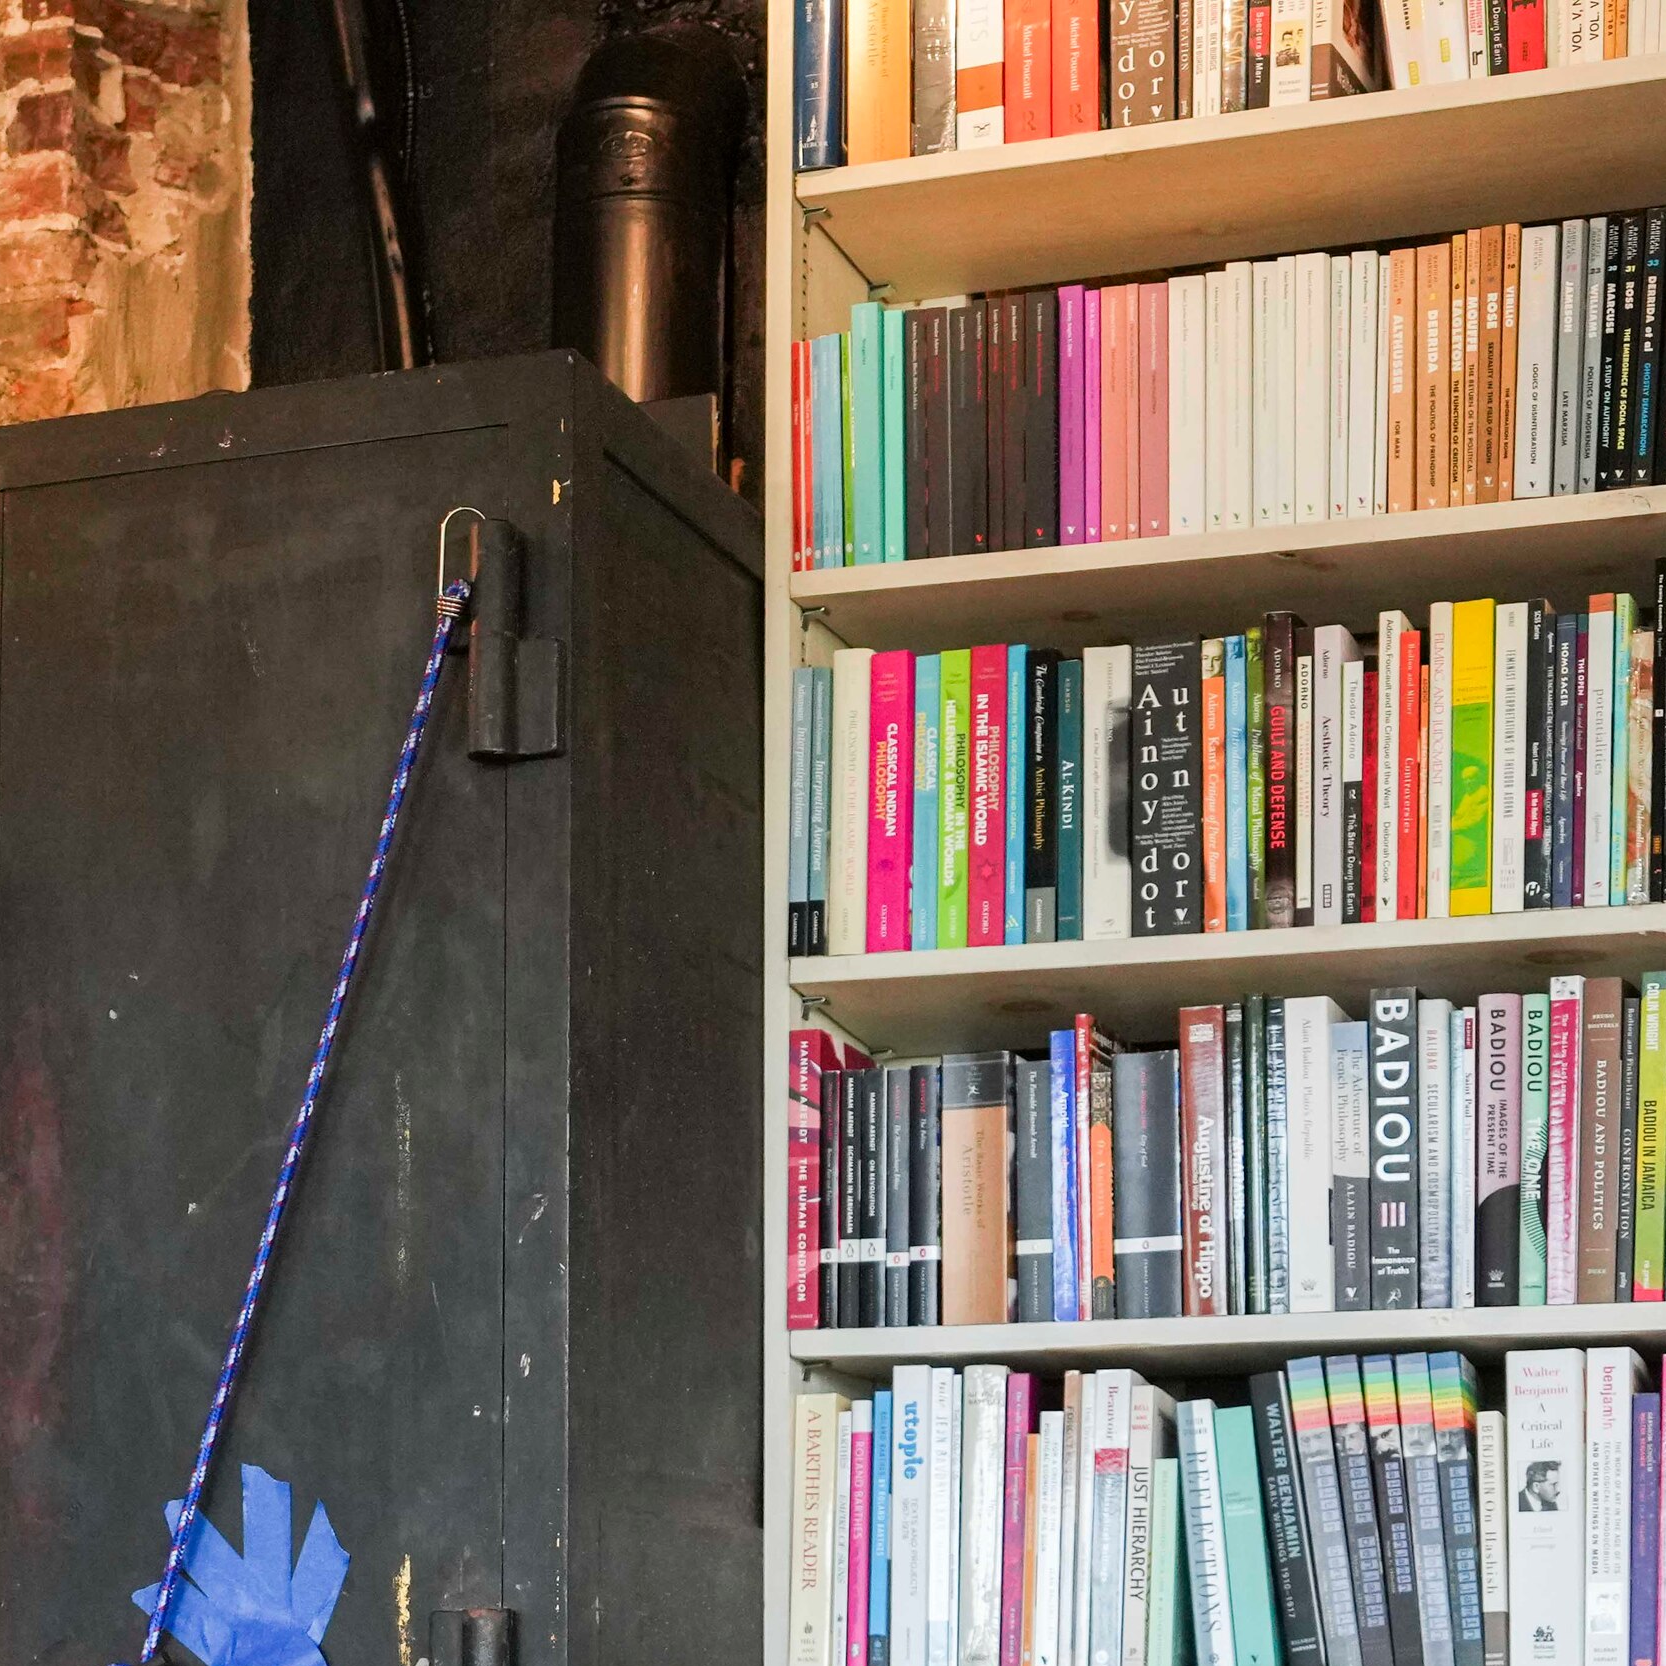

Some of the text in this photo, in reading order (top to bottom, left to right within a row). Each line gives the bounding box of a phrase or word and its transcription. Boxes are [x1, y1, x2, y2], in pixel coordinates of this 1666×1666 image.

[1427, 309, 1438, 374] DERRIDA
[1486, 292, 1498, 330] ROSE
[1605, 283, 1615, 334] MARCUSE
[1391, 316, 1404, 394] ALTHUSSER
[1062, 760, 1075, 830] AL-KINDI
[1270, 706, 1286, 849] GUILT AND DEFENSE
[1490, 1010, 1506, 1091] BADIOU
[1528, 1010, 1543, 1091] BADIOU
[1376, 999, 1410, 1182] BADIOU
[797, 1157, 808, 1302] THE HUMAN CONDITION
[1515, 1384, 1569, 1398] Benjamin
[1522, 1365, 1560, 1378] Walter
[1521, 1419, 1562, 1432] Critical
[1531, 1437, 1554, 1450] Life
[1131, 1466, 1149, 1601] JUST HIERARCHY
